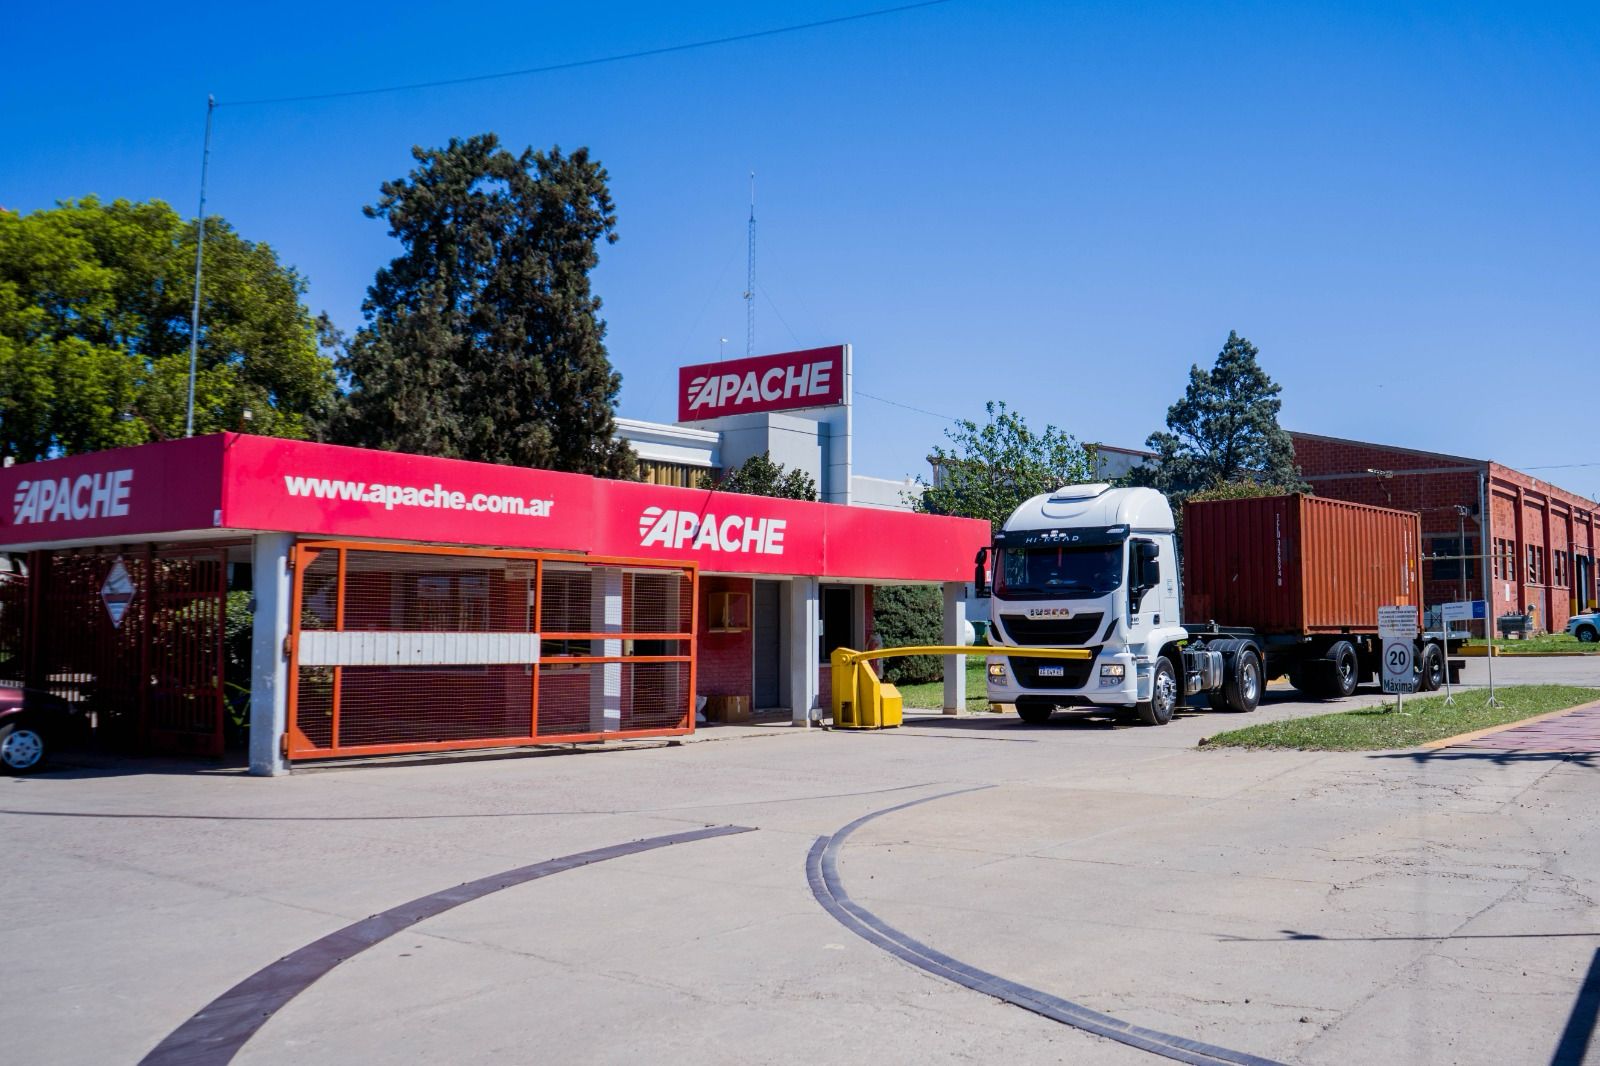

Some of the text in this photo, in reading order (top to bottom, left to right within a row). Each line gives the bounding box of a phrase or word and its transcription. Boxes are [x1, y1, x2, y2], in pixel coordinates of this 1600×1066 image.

[688, 360, 833, 410] APACHE
[14, 469, 134, 525] APACHE
[284, 475, 554, 518] www.apache.com.ar
[639, 506, 787, 555] APACHE
[1389, 650, 1406, 666] 20
[1383, 678, 1413, 692] Máxima
